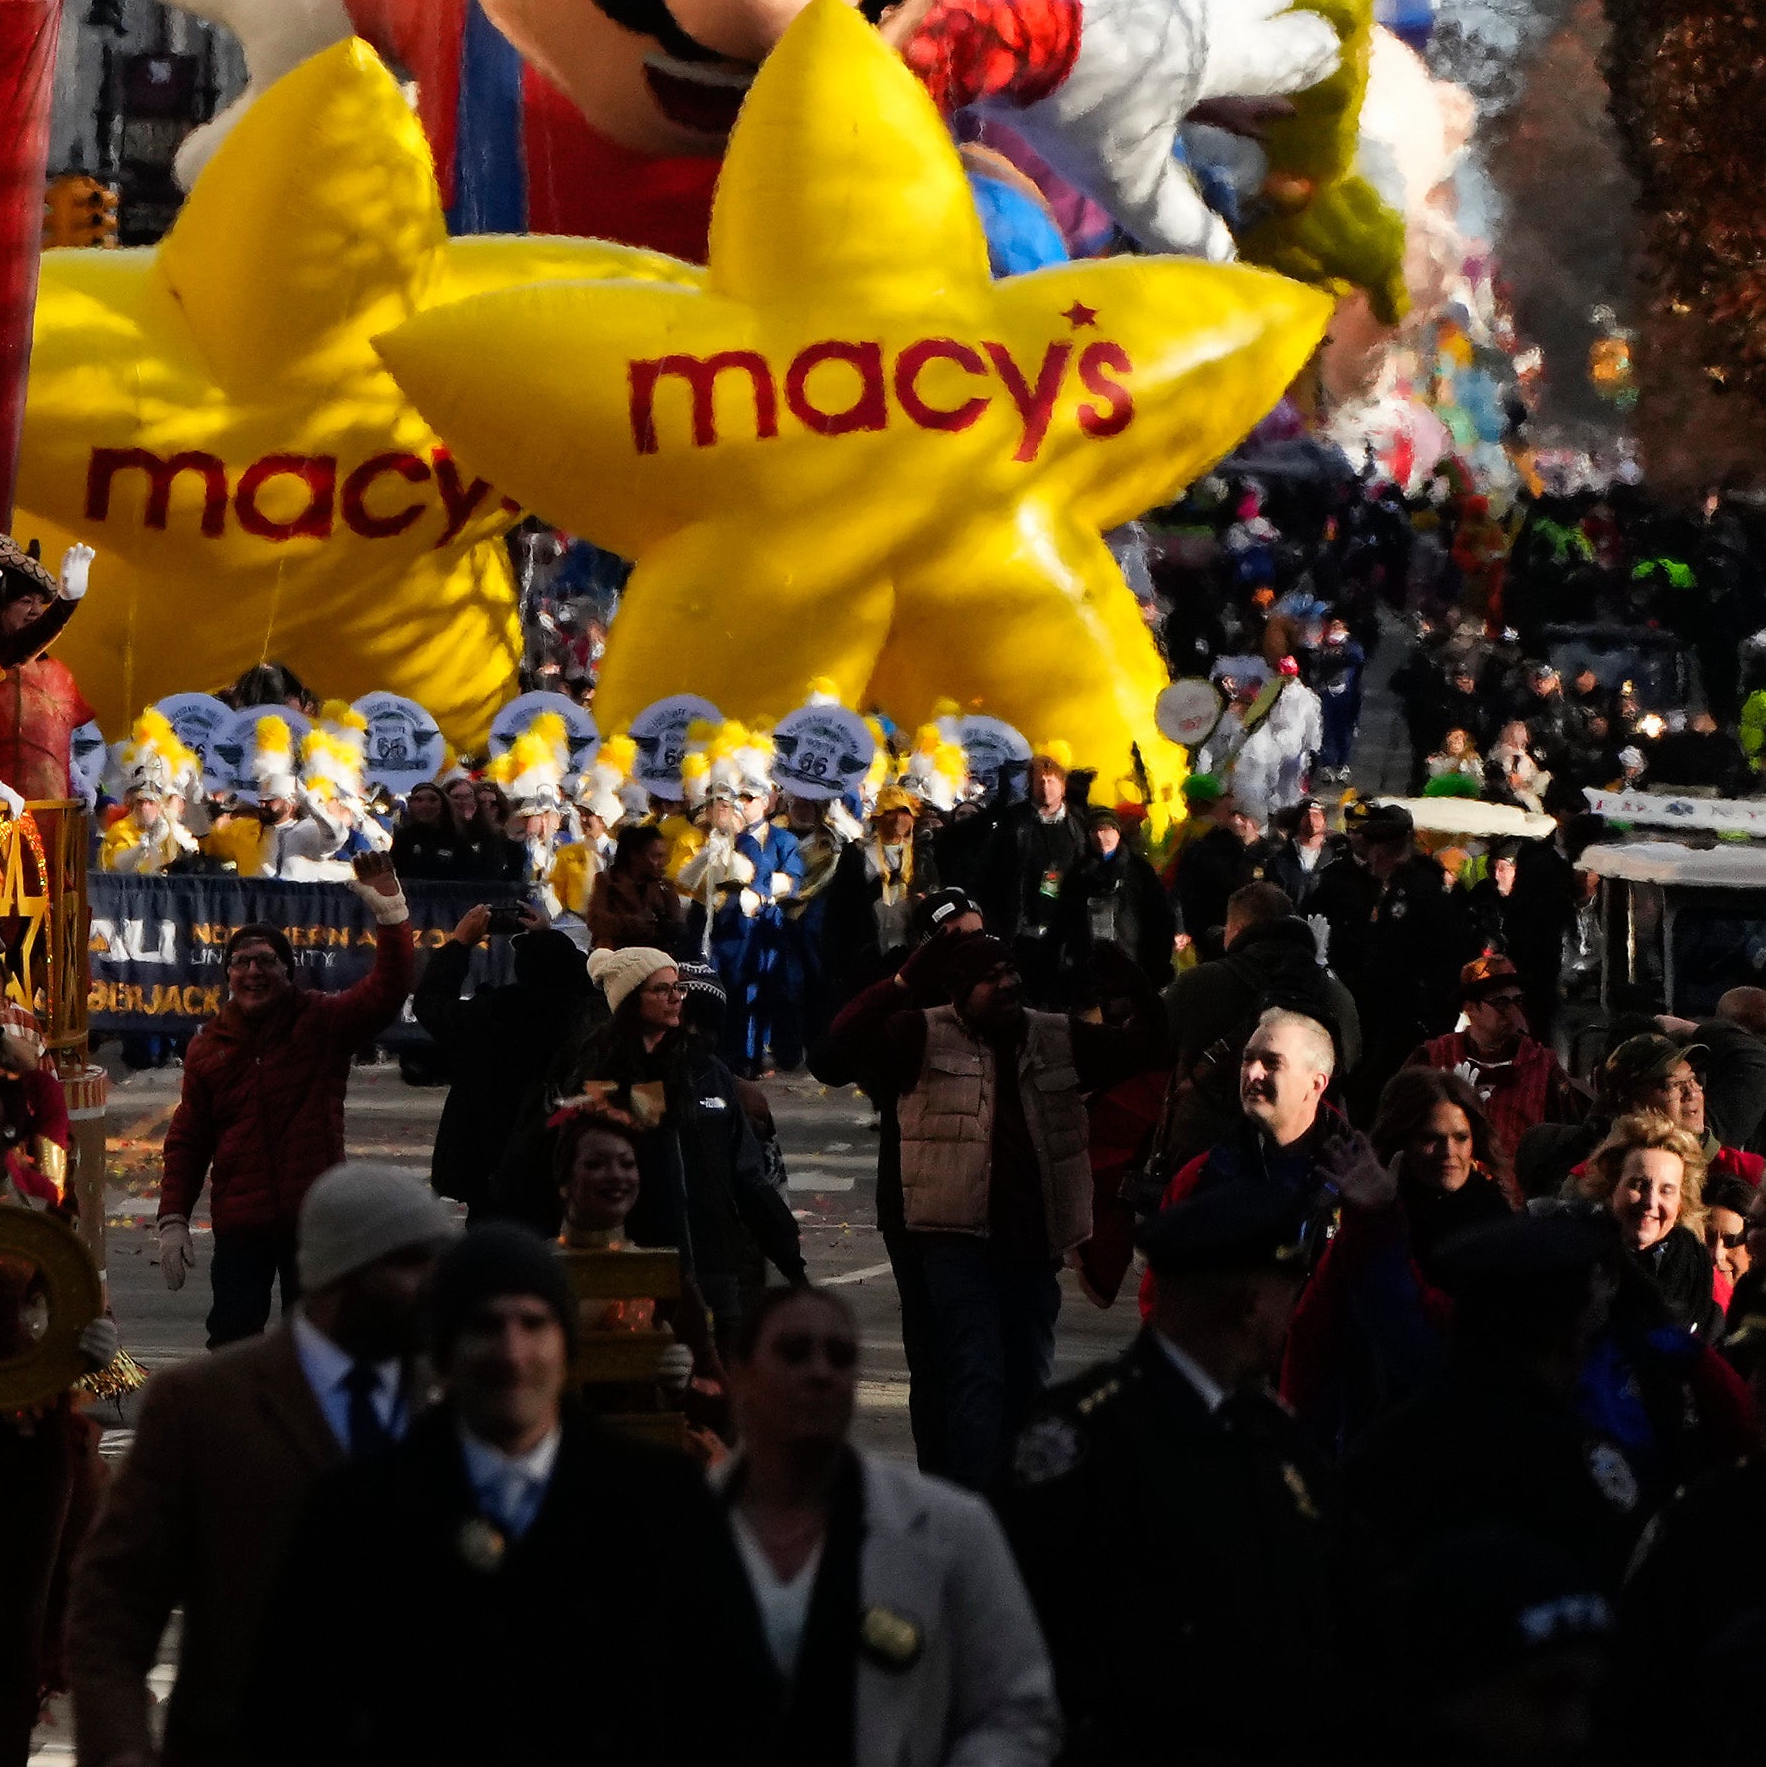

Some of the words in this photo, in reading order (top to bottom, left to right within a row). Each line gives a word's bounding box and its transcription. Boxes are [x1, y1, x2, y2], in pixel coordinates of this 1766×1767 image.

[85, 445, 521, 549] macy
[799, 752, 828, 776] 66
[89, 918, 177, 965] AU
